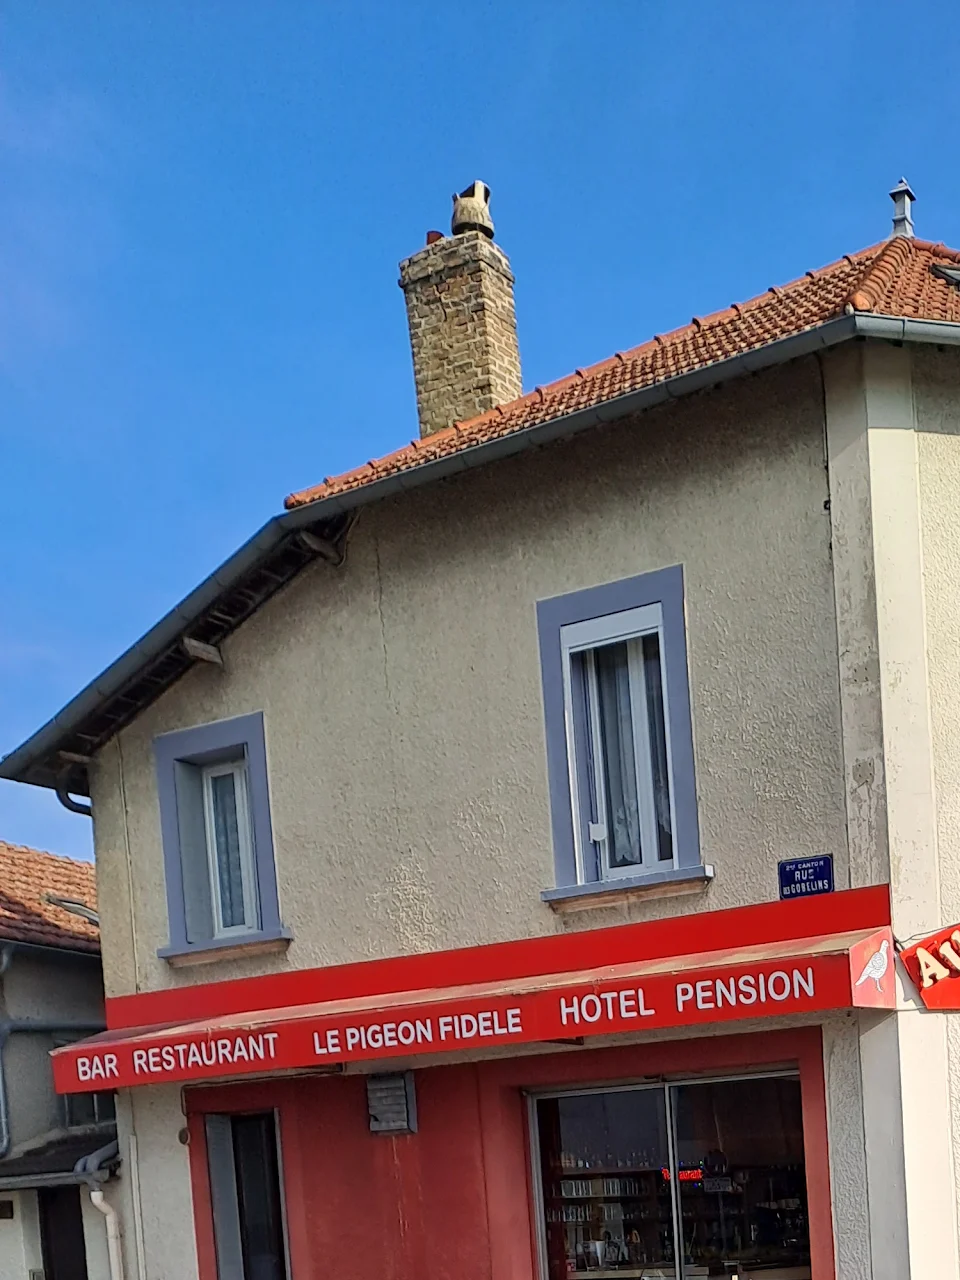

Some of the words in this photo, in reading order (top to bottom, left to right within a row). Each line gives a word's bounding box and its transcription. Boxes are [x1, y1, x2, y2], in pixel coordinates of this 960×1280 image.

[791, 880, 828, 893] GOBELINS
[795, 869, 814, 881] RUE
[559, 987, 656, 1026] HOTEL
[675, 966, 815, 1013] PENSION
[312, 1028, 340, 1056] LE
[345, 1017, 433, 1052] PIGEON
[437, 1007, 523, 1041] FIDELE
[76, 1053, 120, 1082] BAR
[132, 1031, 279, 1076] RESTAURANT
